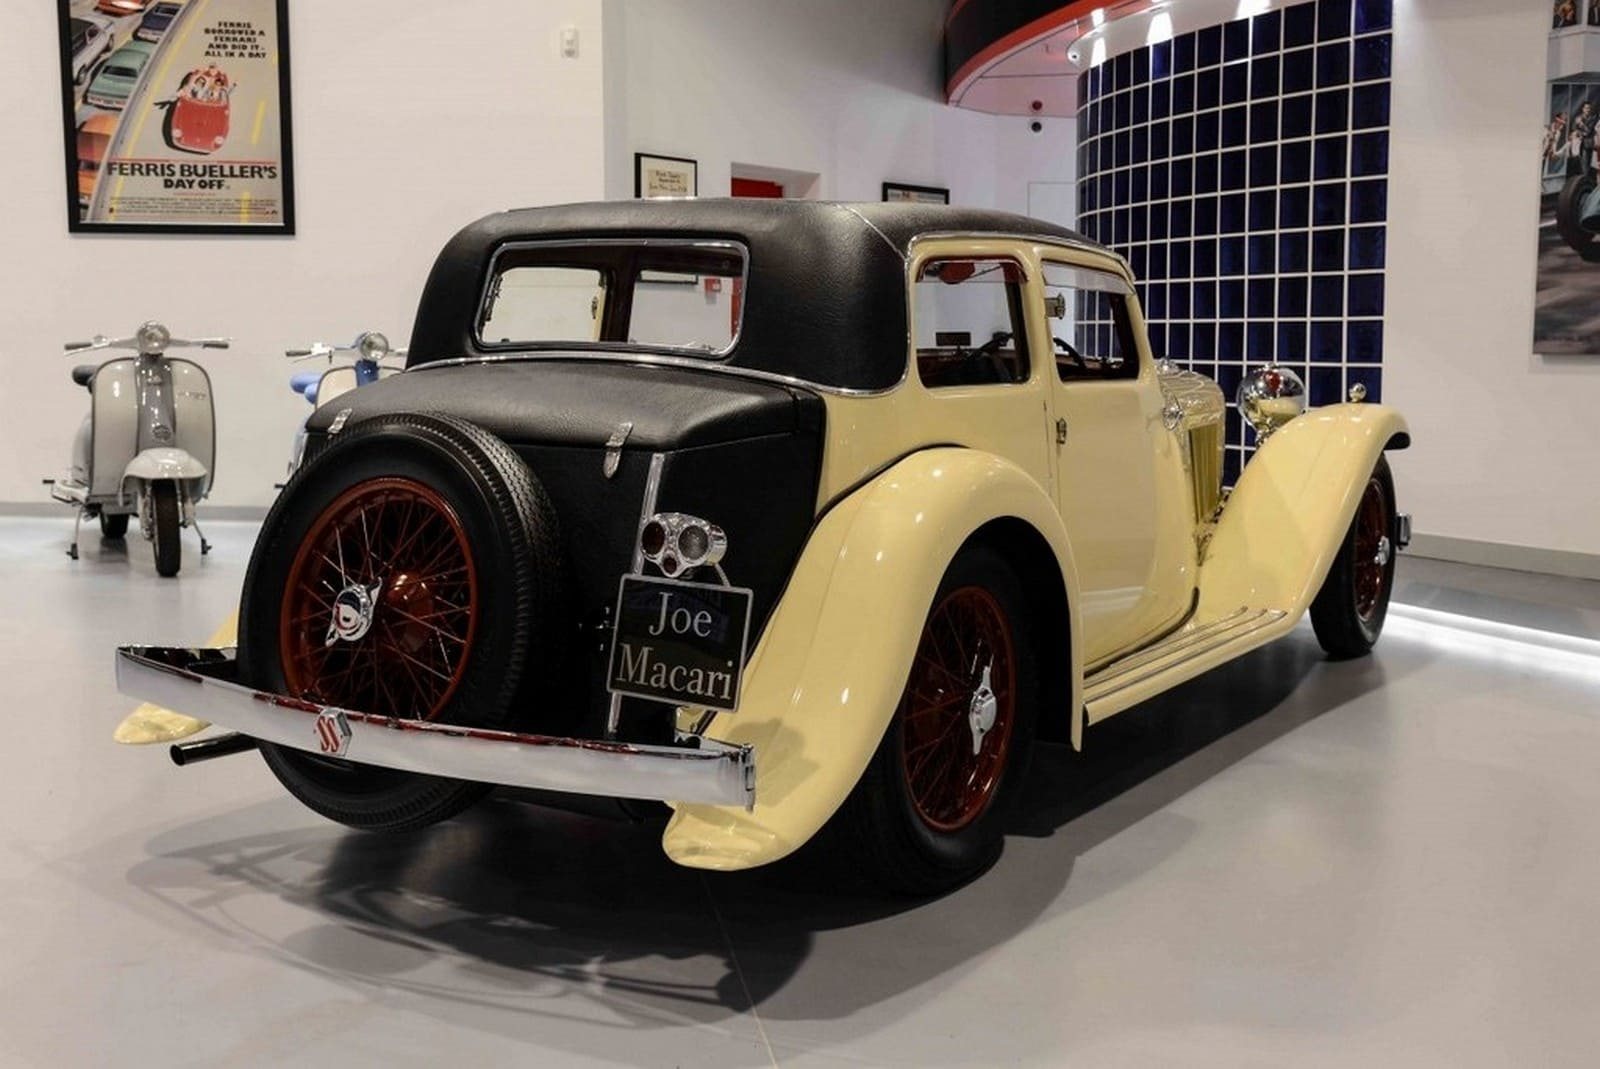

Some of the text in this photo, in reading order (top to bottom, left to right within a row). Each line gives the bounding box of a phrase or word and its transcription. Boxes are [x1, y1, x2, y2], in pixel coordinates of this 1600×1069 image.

[107, 163, 277, 179] FERRIS BUELLER'S
[163, 179, 224, 190] DAY OFF
[649, 591, 712, 637] Joe
[615, 643, 732, 700] Macari
